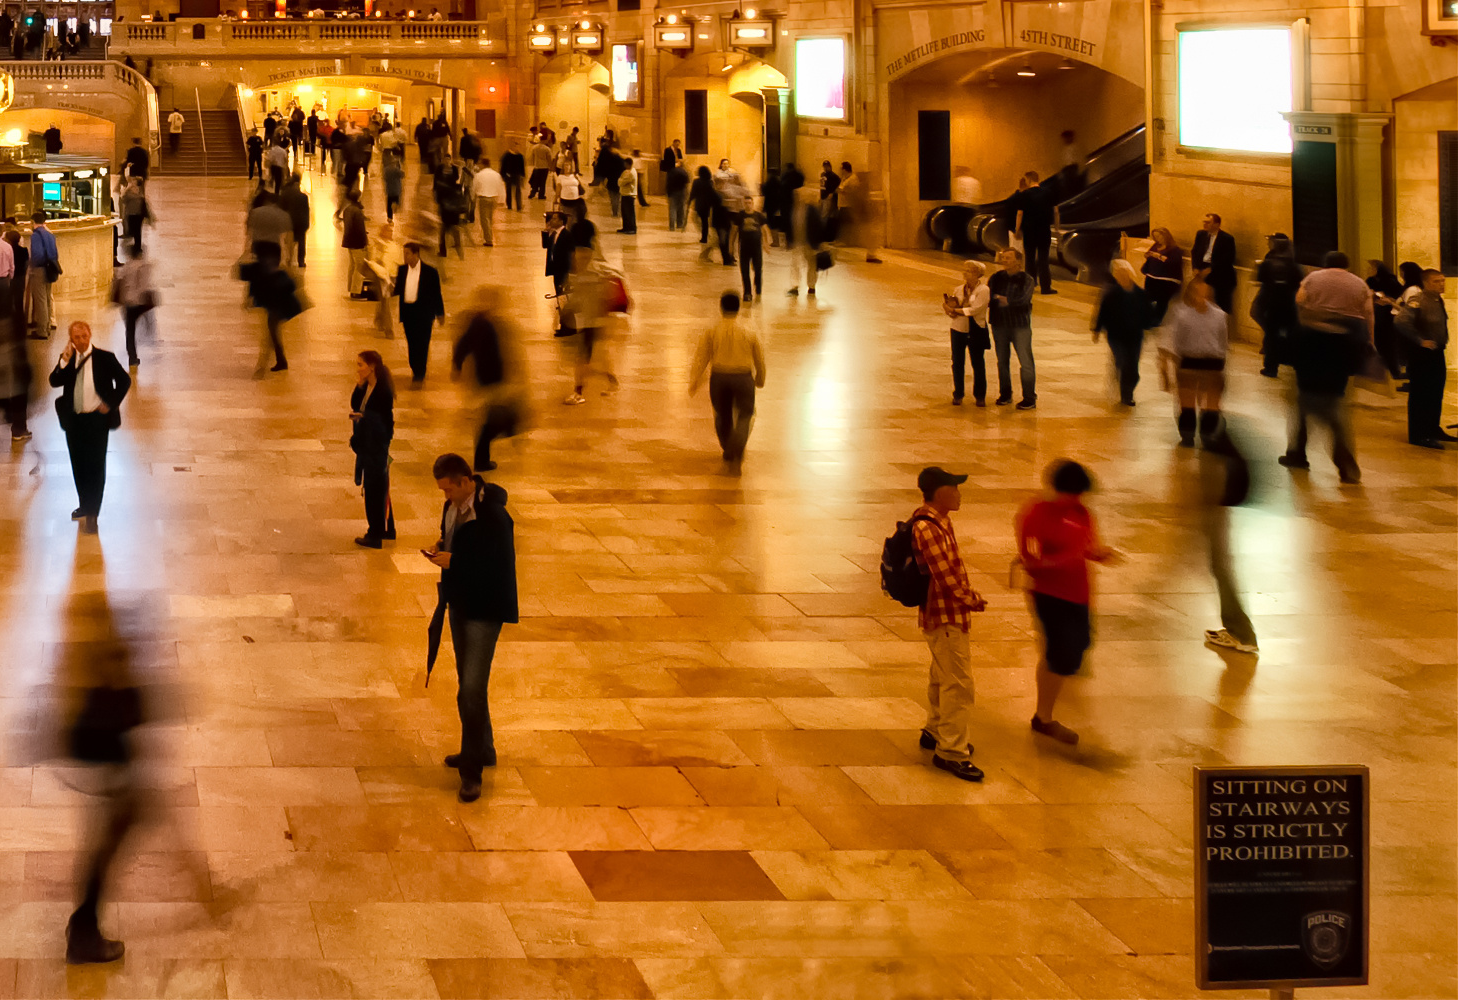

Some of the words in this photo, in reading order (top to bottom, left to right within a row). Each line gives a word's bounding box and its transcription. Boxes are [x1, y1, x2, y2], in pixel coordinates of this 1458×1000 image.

[886, 59, 903, 76] THE
[904, 40, 940, 66] METLIFE
[940, 29, 985, 50] BUILDING
[1020, 29, 1048, 46] 45TH
[1050, 33, 1096, 57] STREET
[268, 70, 296, 81] TICKET
[370, 66, 403, 74] TRACKS
[414, 70, 425, 78] TO
[1212, 779, 1307, 795] SITTING
[1314, 779, 1348, 794] ON
[1209, 801, 1351, 817] STAIRWAYS
[1206, 824, 1226, 839] IS
[1233, 822, 1349, 838] STRICTLY
[1206, 844, 1354, 861] PROHIBITED.
[1307, 914, 1346, 929] POLICE
